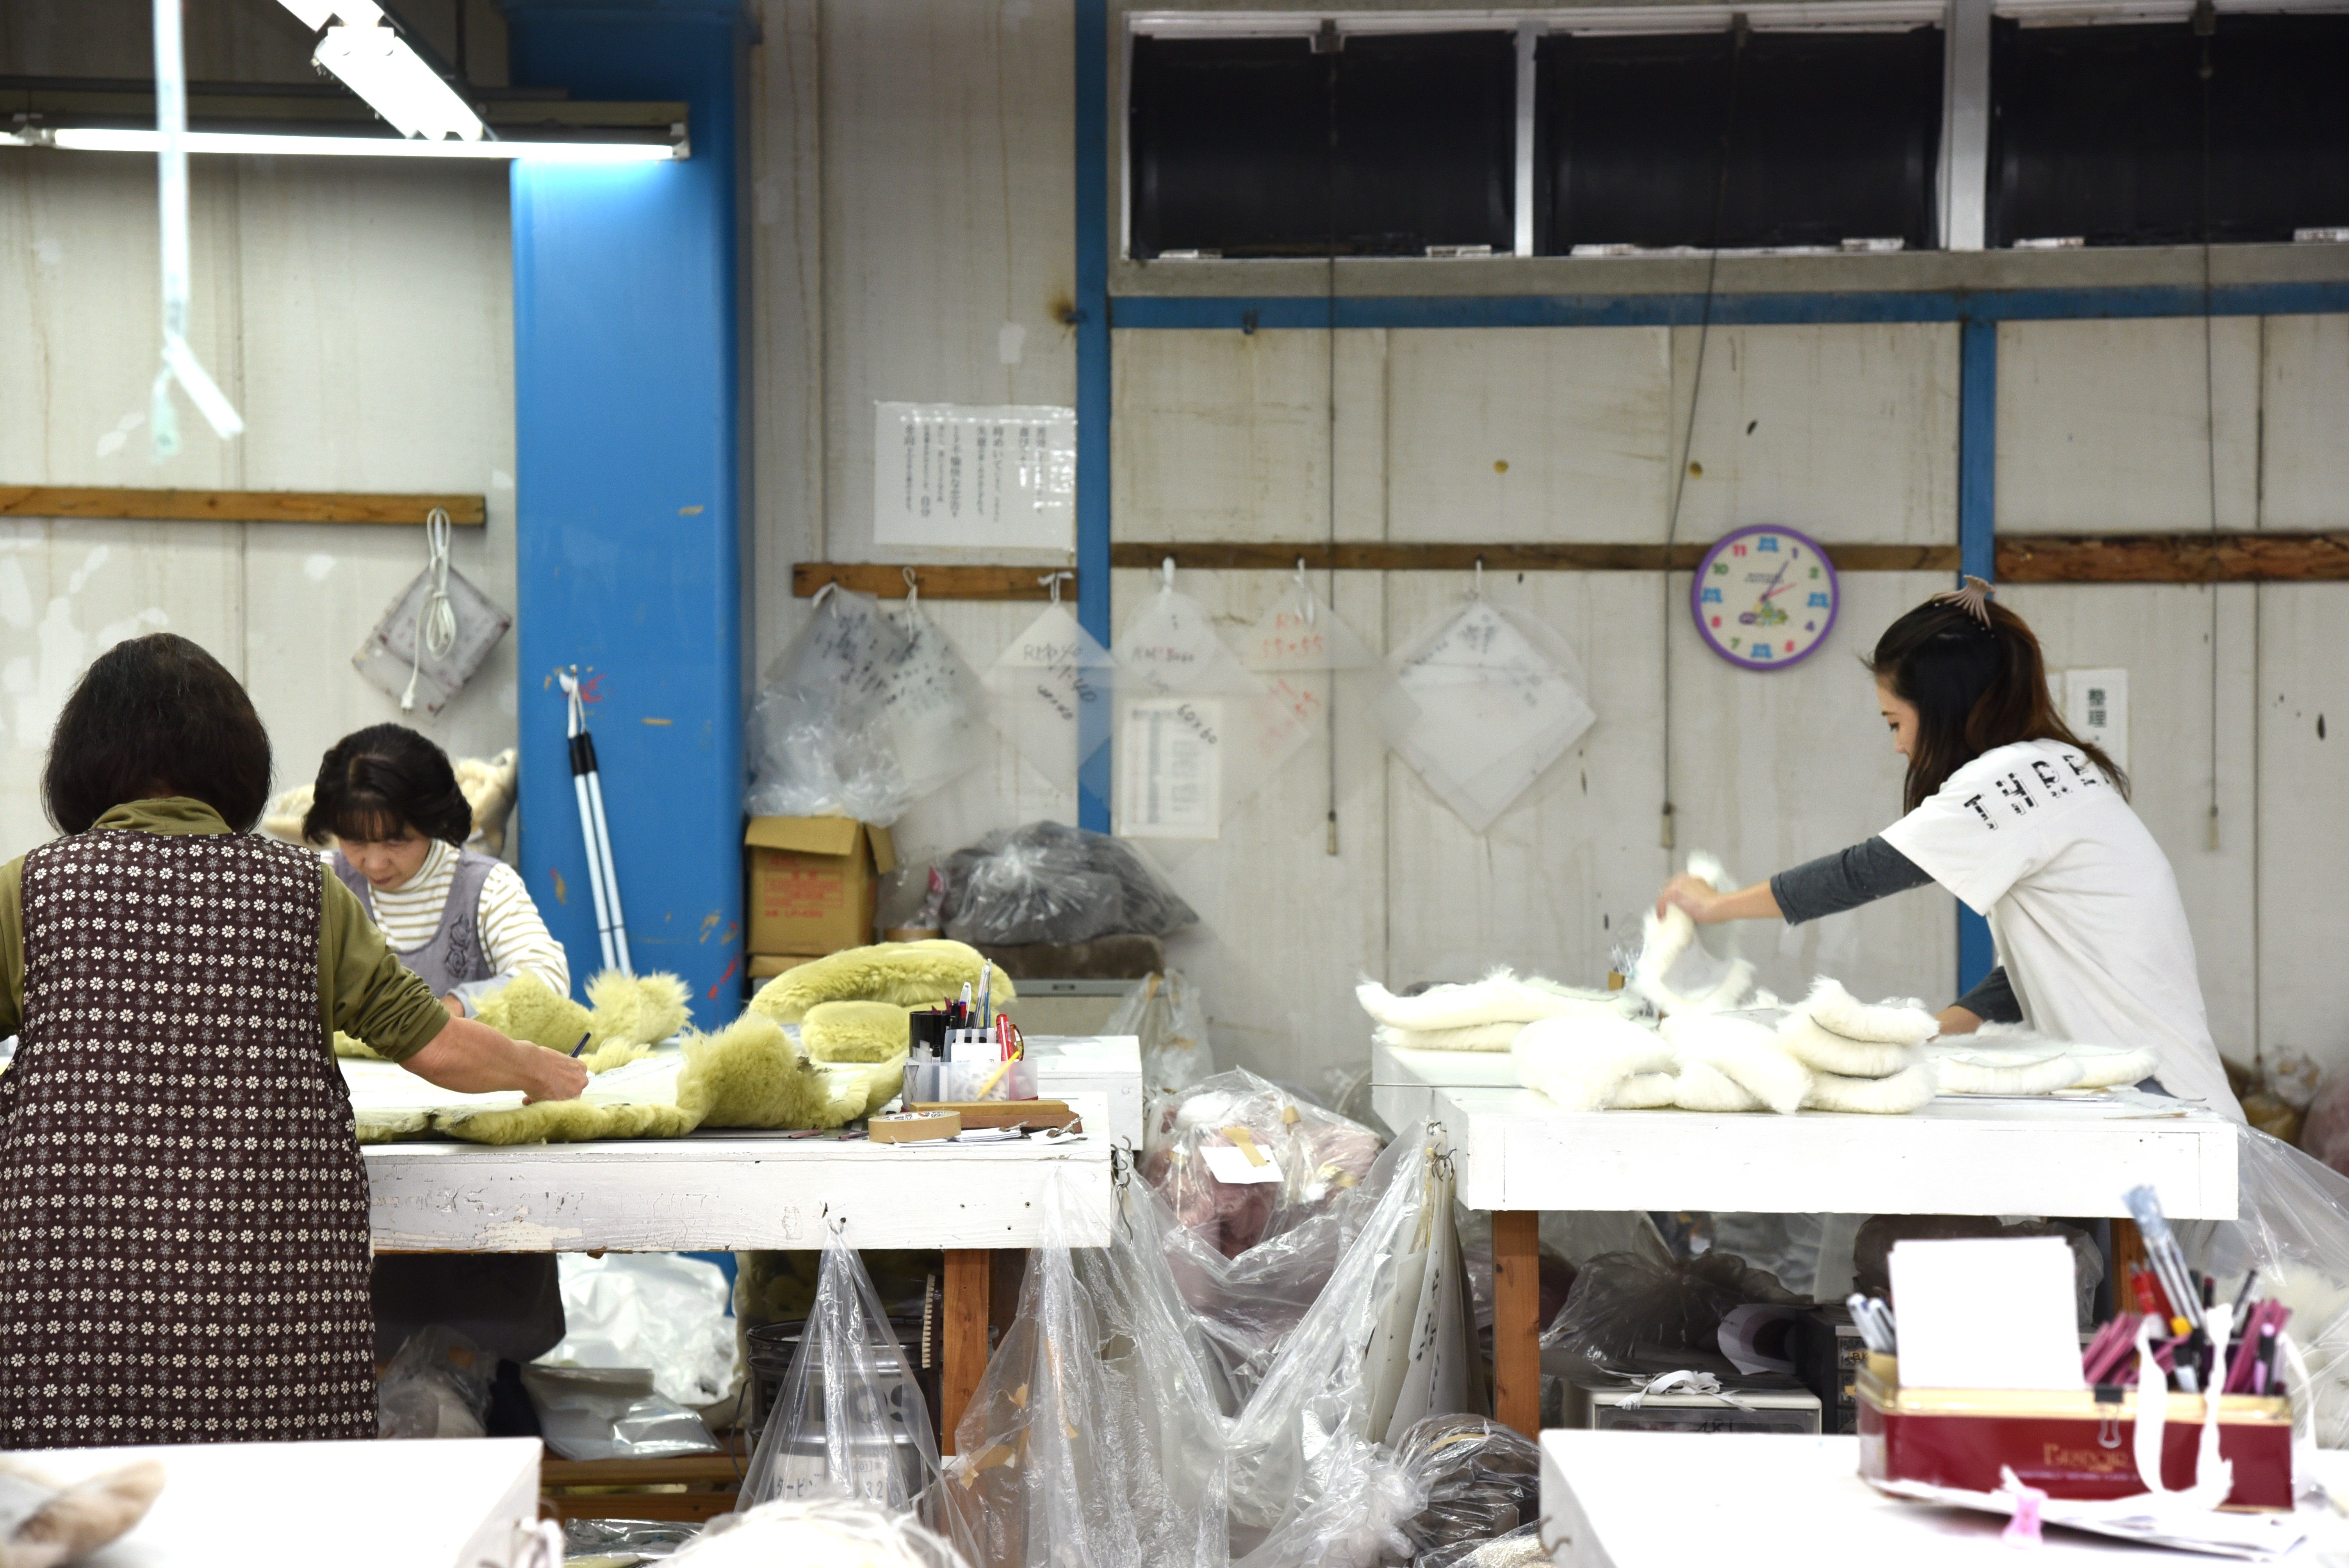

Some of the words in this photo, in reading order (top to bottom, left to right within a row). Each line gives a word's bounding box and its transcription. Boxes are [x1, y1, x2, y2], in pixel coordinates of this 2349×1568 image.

[1733, 544, 1747, 557] 11
[1792, 547, 1798, 559] 1
[1713, 563, 1729, 575] 10
[1809, 567, 1819, 579] 2
[1730, 637, 1741, 649] 7
[1964, 753, 2110, 831] THRE
